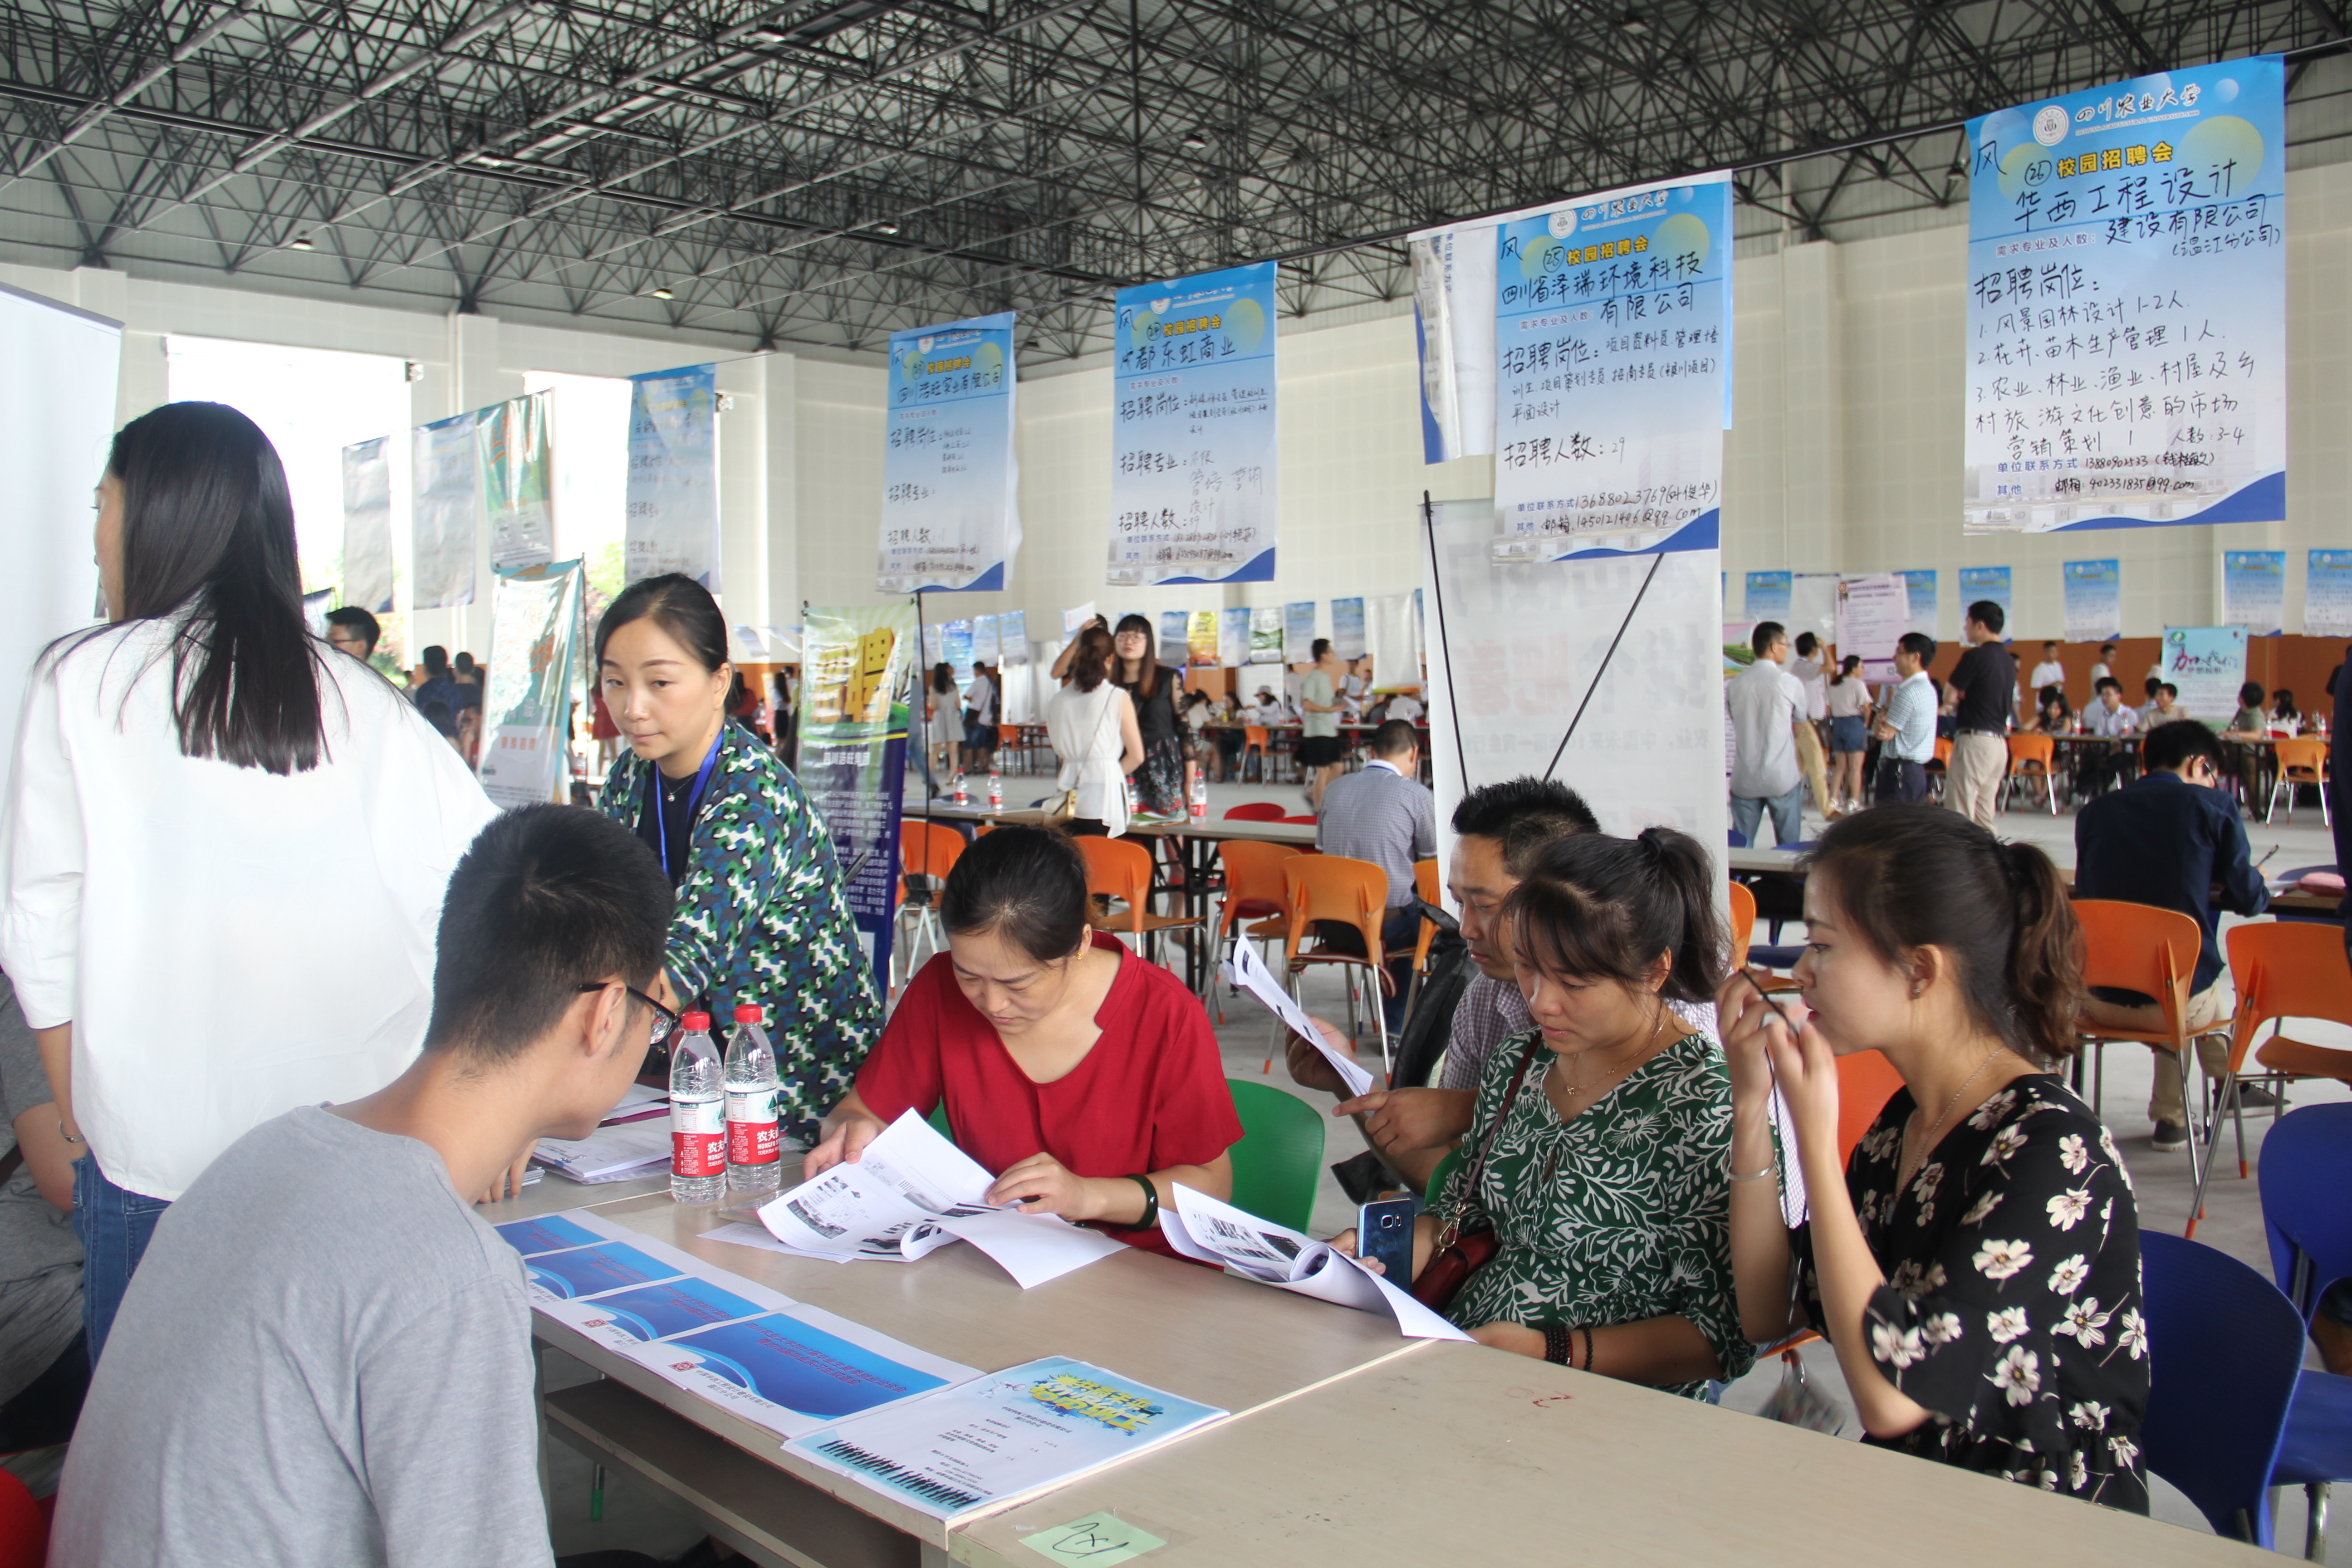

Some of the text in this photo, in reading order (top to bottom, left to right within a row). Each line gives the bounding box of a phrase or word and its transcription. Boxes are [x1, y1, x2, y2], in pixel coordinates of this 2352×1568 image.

[2075, 83, 2201, 122] 四川农业大学
[1975, 141, 2007, 176] 风
[2057, 142, 2173, 179] 校园招聘会
[1581, 189, 1669, 220] 四川农业大学
[2015, 159, 2237, 232] 华西工程设计
[2106, 194, 2266, 245] 建设有限公司
[1501, 237, 1523, 261] 风
[1567, 235, 1649, 267] 校园招聘会
[1996, 233, 2097, 258] 需求专业及人数：
[1502, 251, 1703, 308] 四川省泽瑞环境科技
[1974, 262, 2099, 308] 招聘岗位：
[1600, 282, 1695, 328] 有限公司
[1119, 309, 1137, 331] 风
[1163, 314, 1222, 338] 校园招聘会
[927, 356, 971, 375] 校园招聘会
[1502, 333, 1599, 378] 招聘岗位：
[1511, 400, 1561, 426] 平面设计
[1975, 391, 2238, 433] 村旅游文化创意的市场
[1503, 432, 1604, 470] 招聘人数：
[2007, 429, 2101, 460] 营销策划
[1120, 450, 1187, 476] 招聘专业：
[1997, 458, 2078, 473] 单位联系方式
[1996, 484, 2022, 496] 其他
[1517, 499, 1574, 513] 单位联系方式
[1118, 507, 1187, 533] 招聘人数：
[1516, 522, 1534, 532] 其他
[1126, 534, 1170, 544] 单位联系方式
[707, 1140, 725, 1155] 农夫
[757, 1141, 775, 1150] NONGFU
